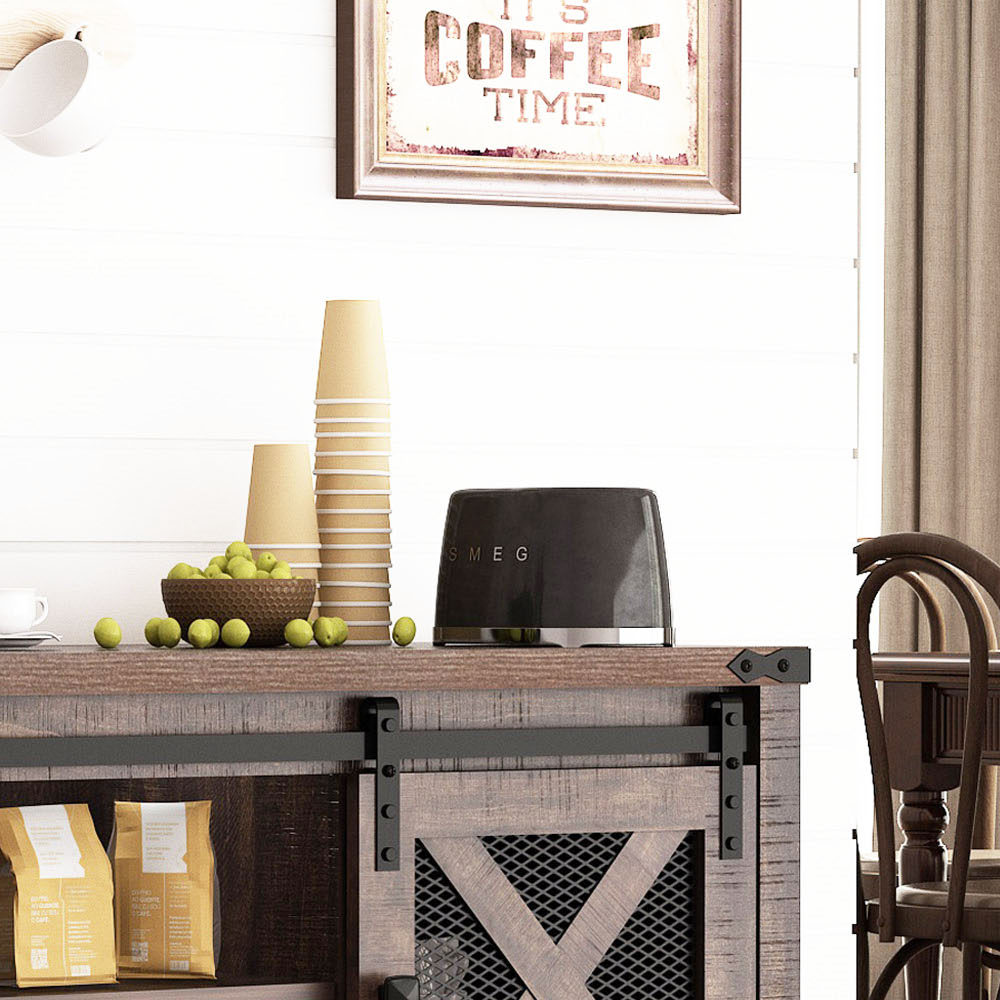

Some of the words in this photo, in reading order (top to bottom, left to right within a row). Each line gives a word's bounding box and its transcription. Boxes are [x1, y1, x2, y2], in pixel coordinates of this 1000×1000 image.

[424, 10, 660, 100] COFFEE
[483, 87, 606, 127] TIME
[449, 546, 529, 562] SMEG
